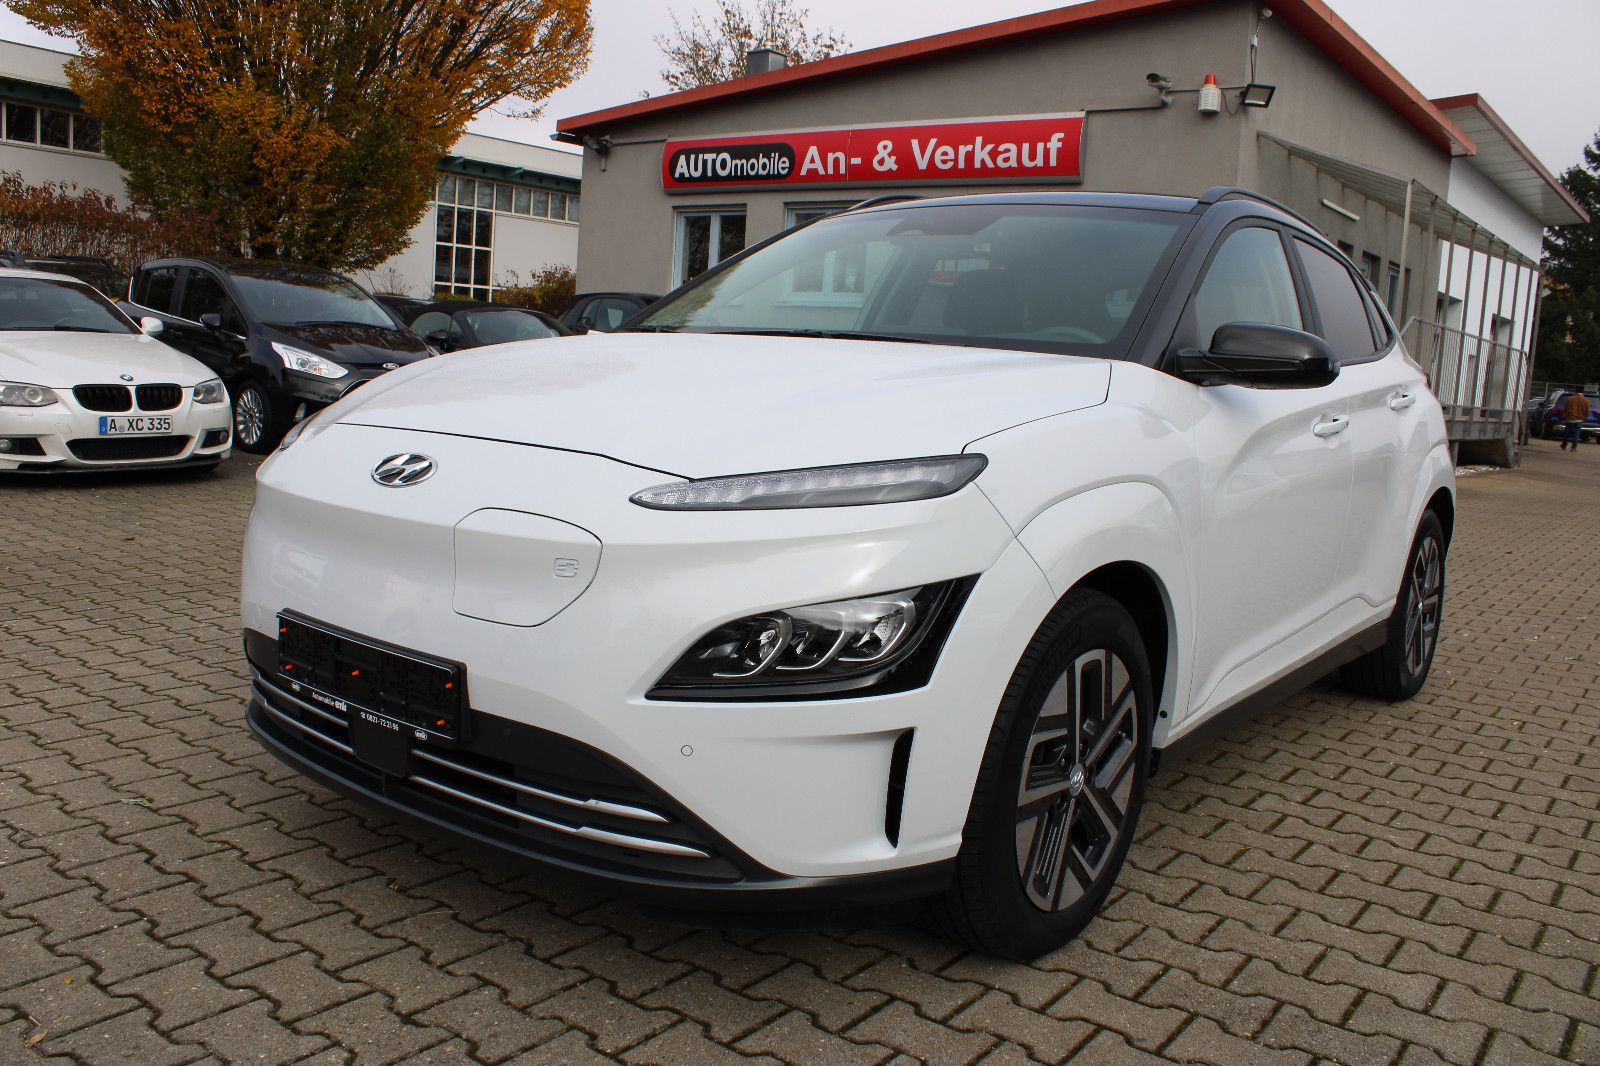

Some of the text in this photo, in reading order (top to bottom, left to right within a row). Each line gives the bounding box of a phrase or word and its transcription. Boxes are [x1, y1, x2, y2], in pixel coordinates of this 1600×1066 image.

[675, 132, 1065, 178] AUTOmobile An- & Verkauf
[109, 417, 171, 432] A XC 335
